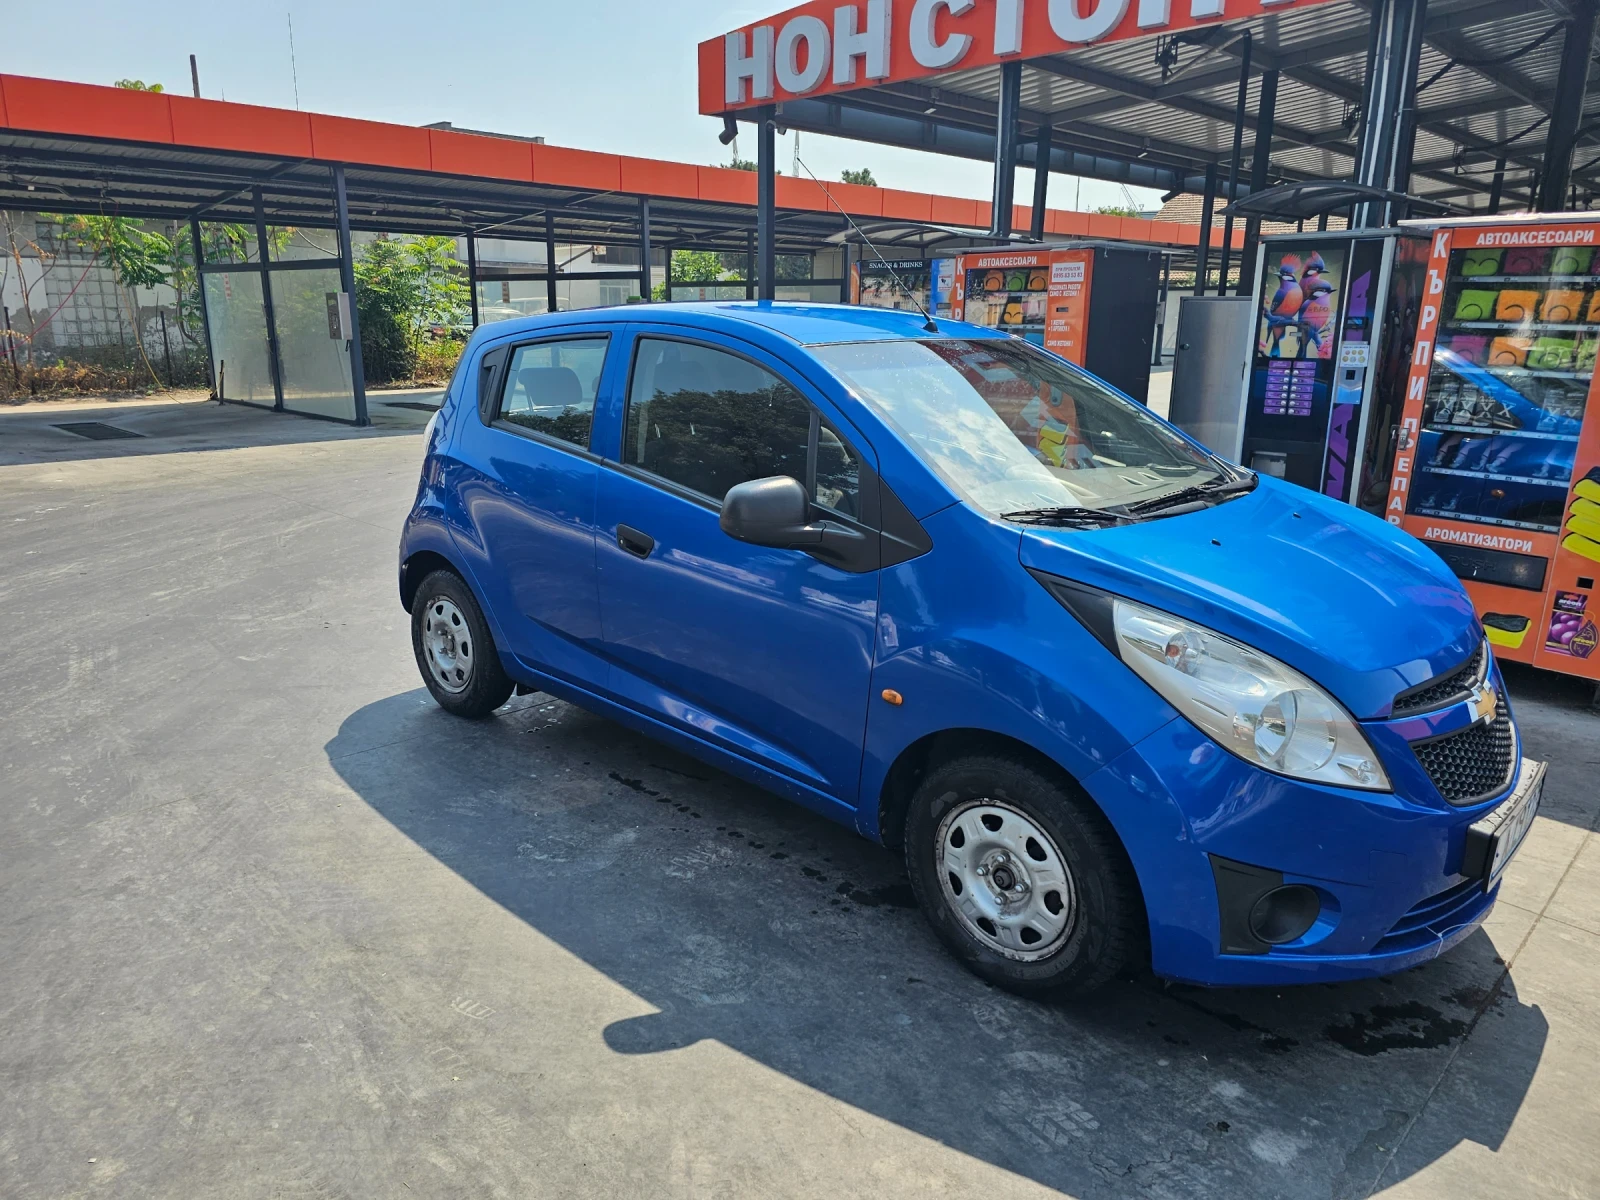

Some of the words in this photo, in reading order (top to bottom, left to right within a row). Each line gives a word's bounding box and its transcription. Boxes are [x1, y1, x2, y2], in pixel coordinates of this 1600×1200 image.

[725, 1, 890, 104] НОН
[1476, 229, 1595, 246] АВТОАКСЕСОАРИ
[978, 256, 1038, 267] АВТОАКСЕСОАРИ
[1408, 232, 1450, 401] КЪРПИ
[1424, 526, 1533, 552] АРОМАТИЗАТОРИ
